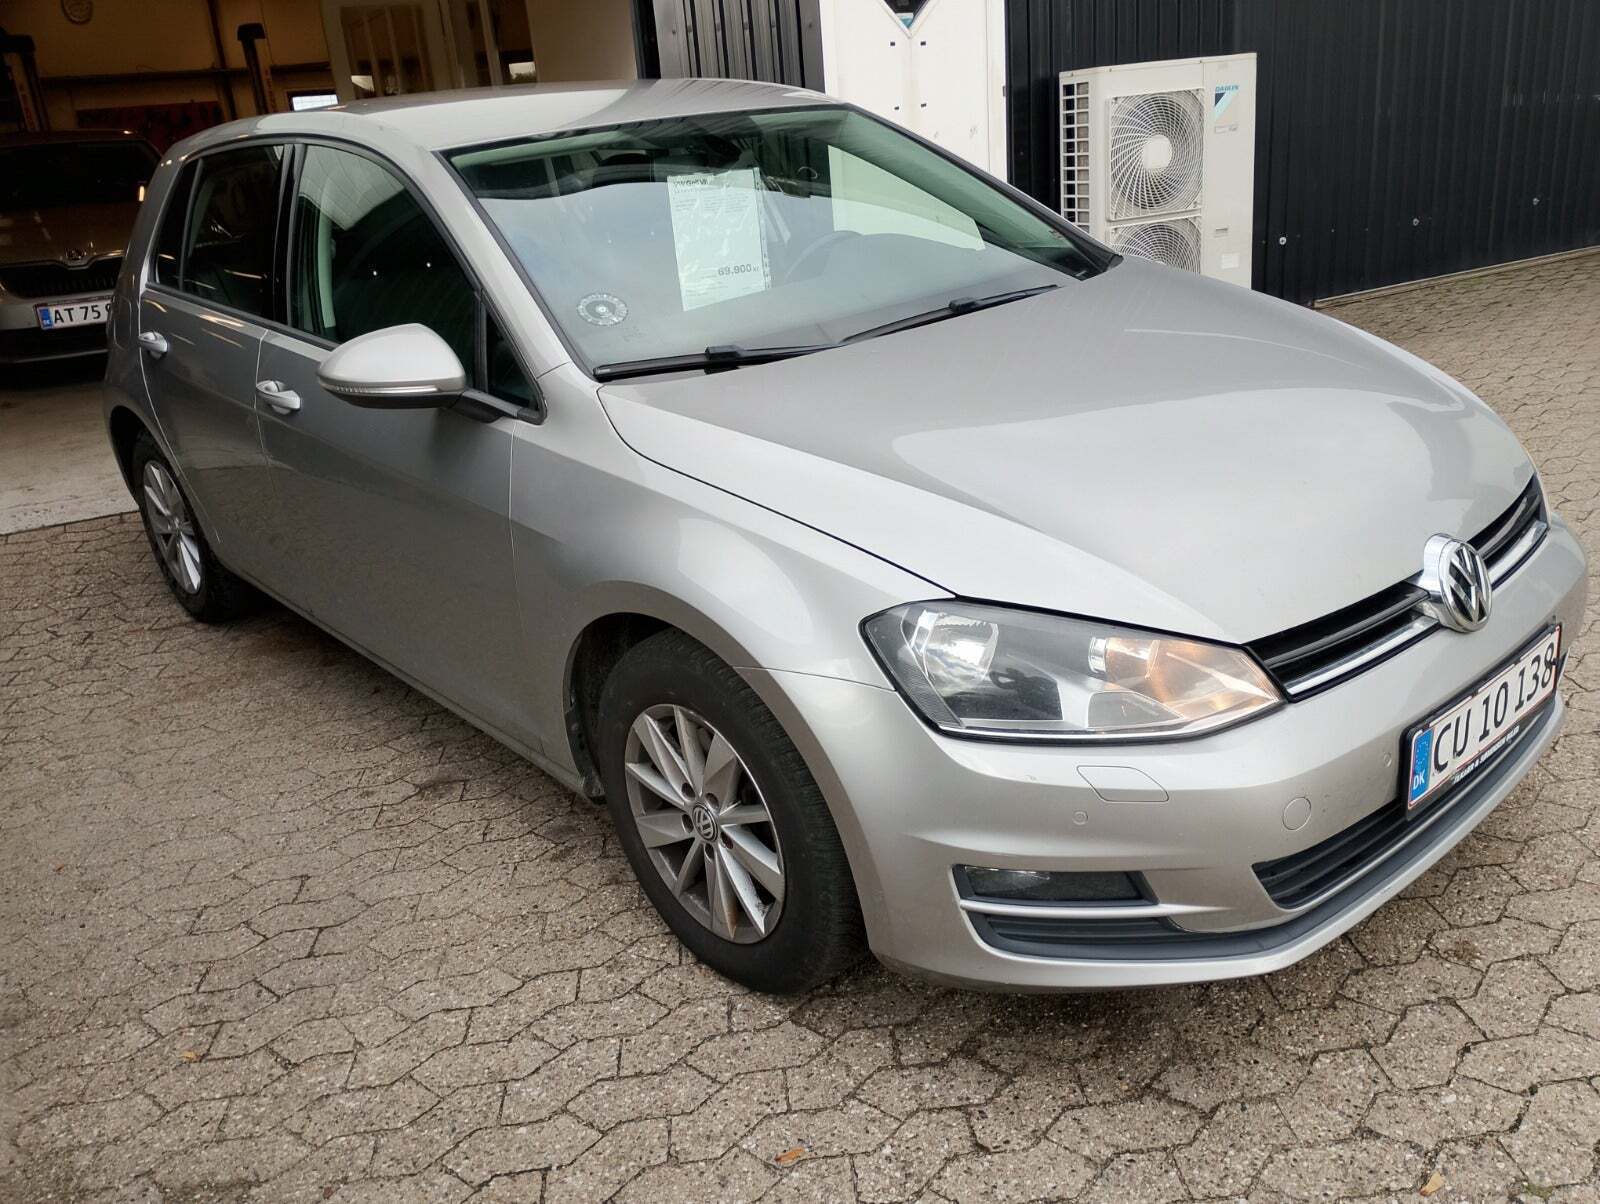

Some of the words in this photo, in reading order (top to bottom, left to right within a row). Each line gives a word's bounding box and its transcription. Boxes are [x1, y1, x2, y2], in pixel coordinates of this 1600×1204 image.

[54, 308, 74, 324] AT
[79, 304, 101, 321] 75
[1434, 708, 1471, 773] CU
[1478, 681, 1509, 743] 10
[1514, 641, 1556, 713] 138
[1412, 769, 1426, 790] DK
